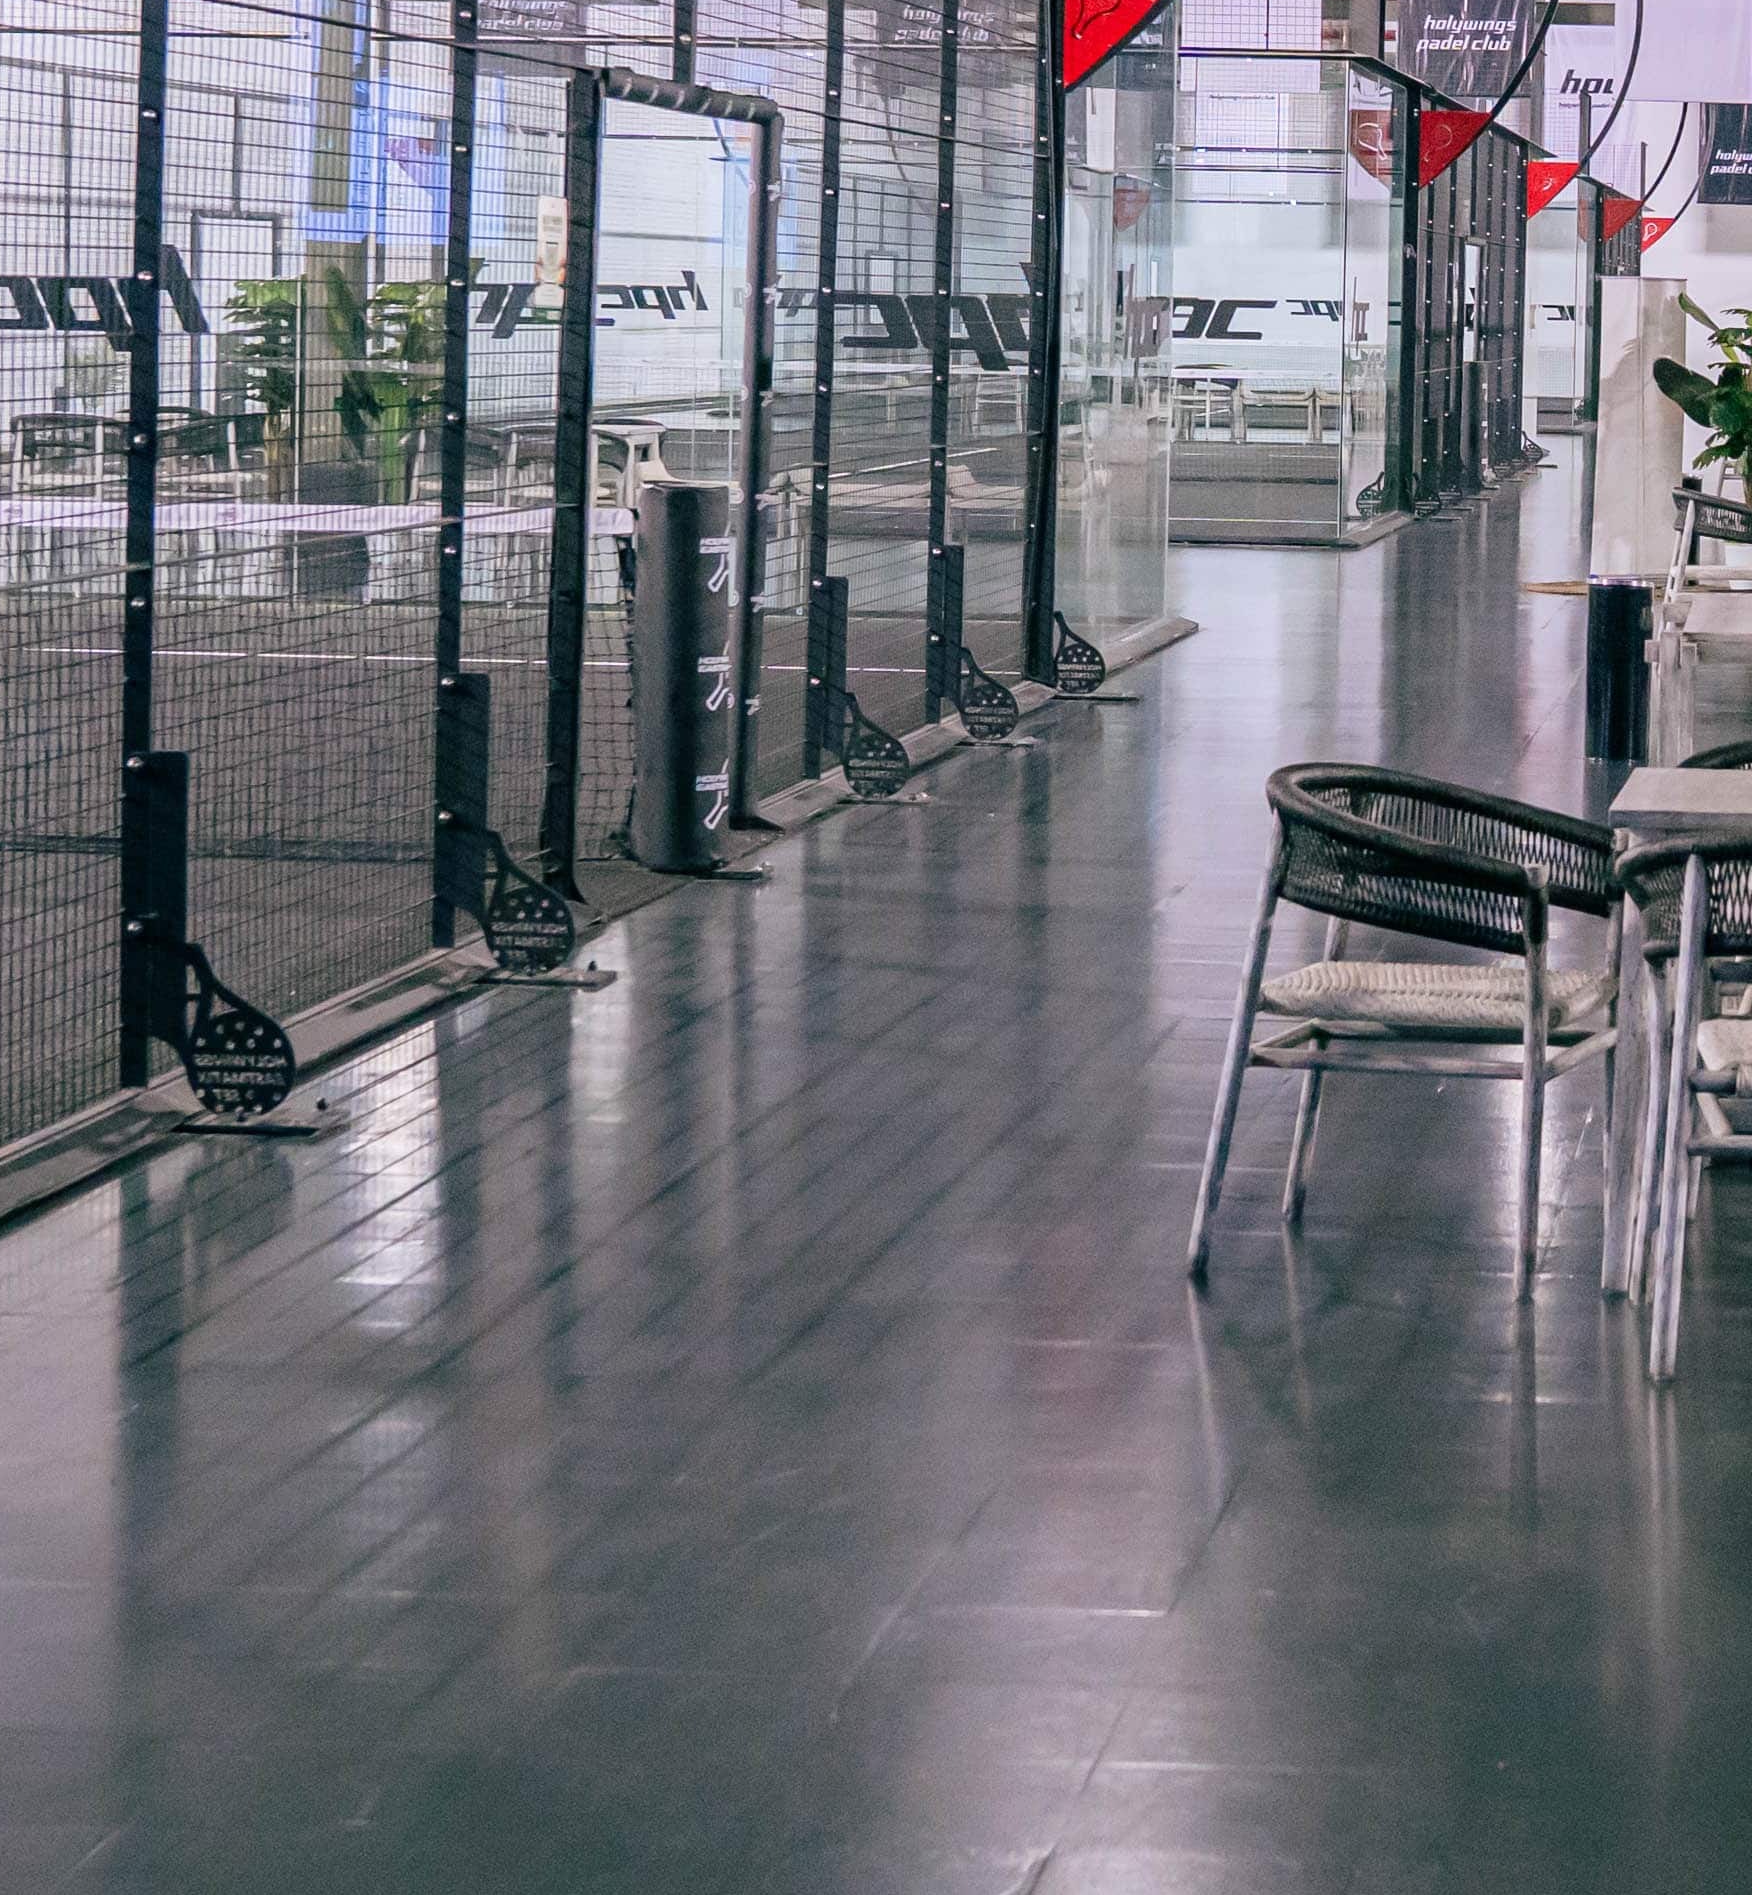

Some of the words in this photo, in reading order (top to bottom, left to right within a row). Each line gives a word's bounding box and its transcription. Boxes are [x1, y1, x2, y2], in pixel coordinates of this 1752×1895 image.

[1424, 14, 1518, 34] holywings
[1416, 34, 1470, 52] padel
[1471, 34, 1512, 52] club
[1710, 164, 1748, 176] padel
